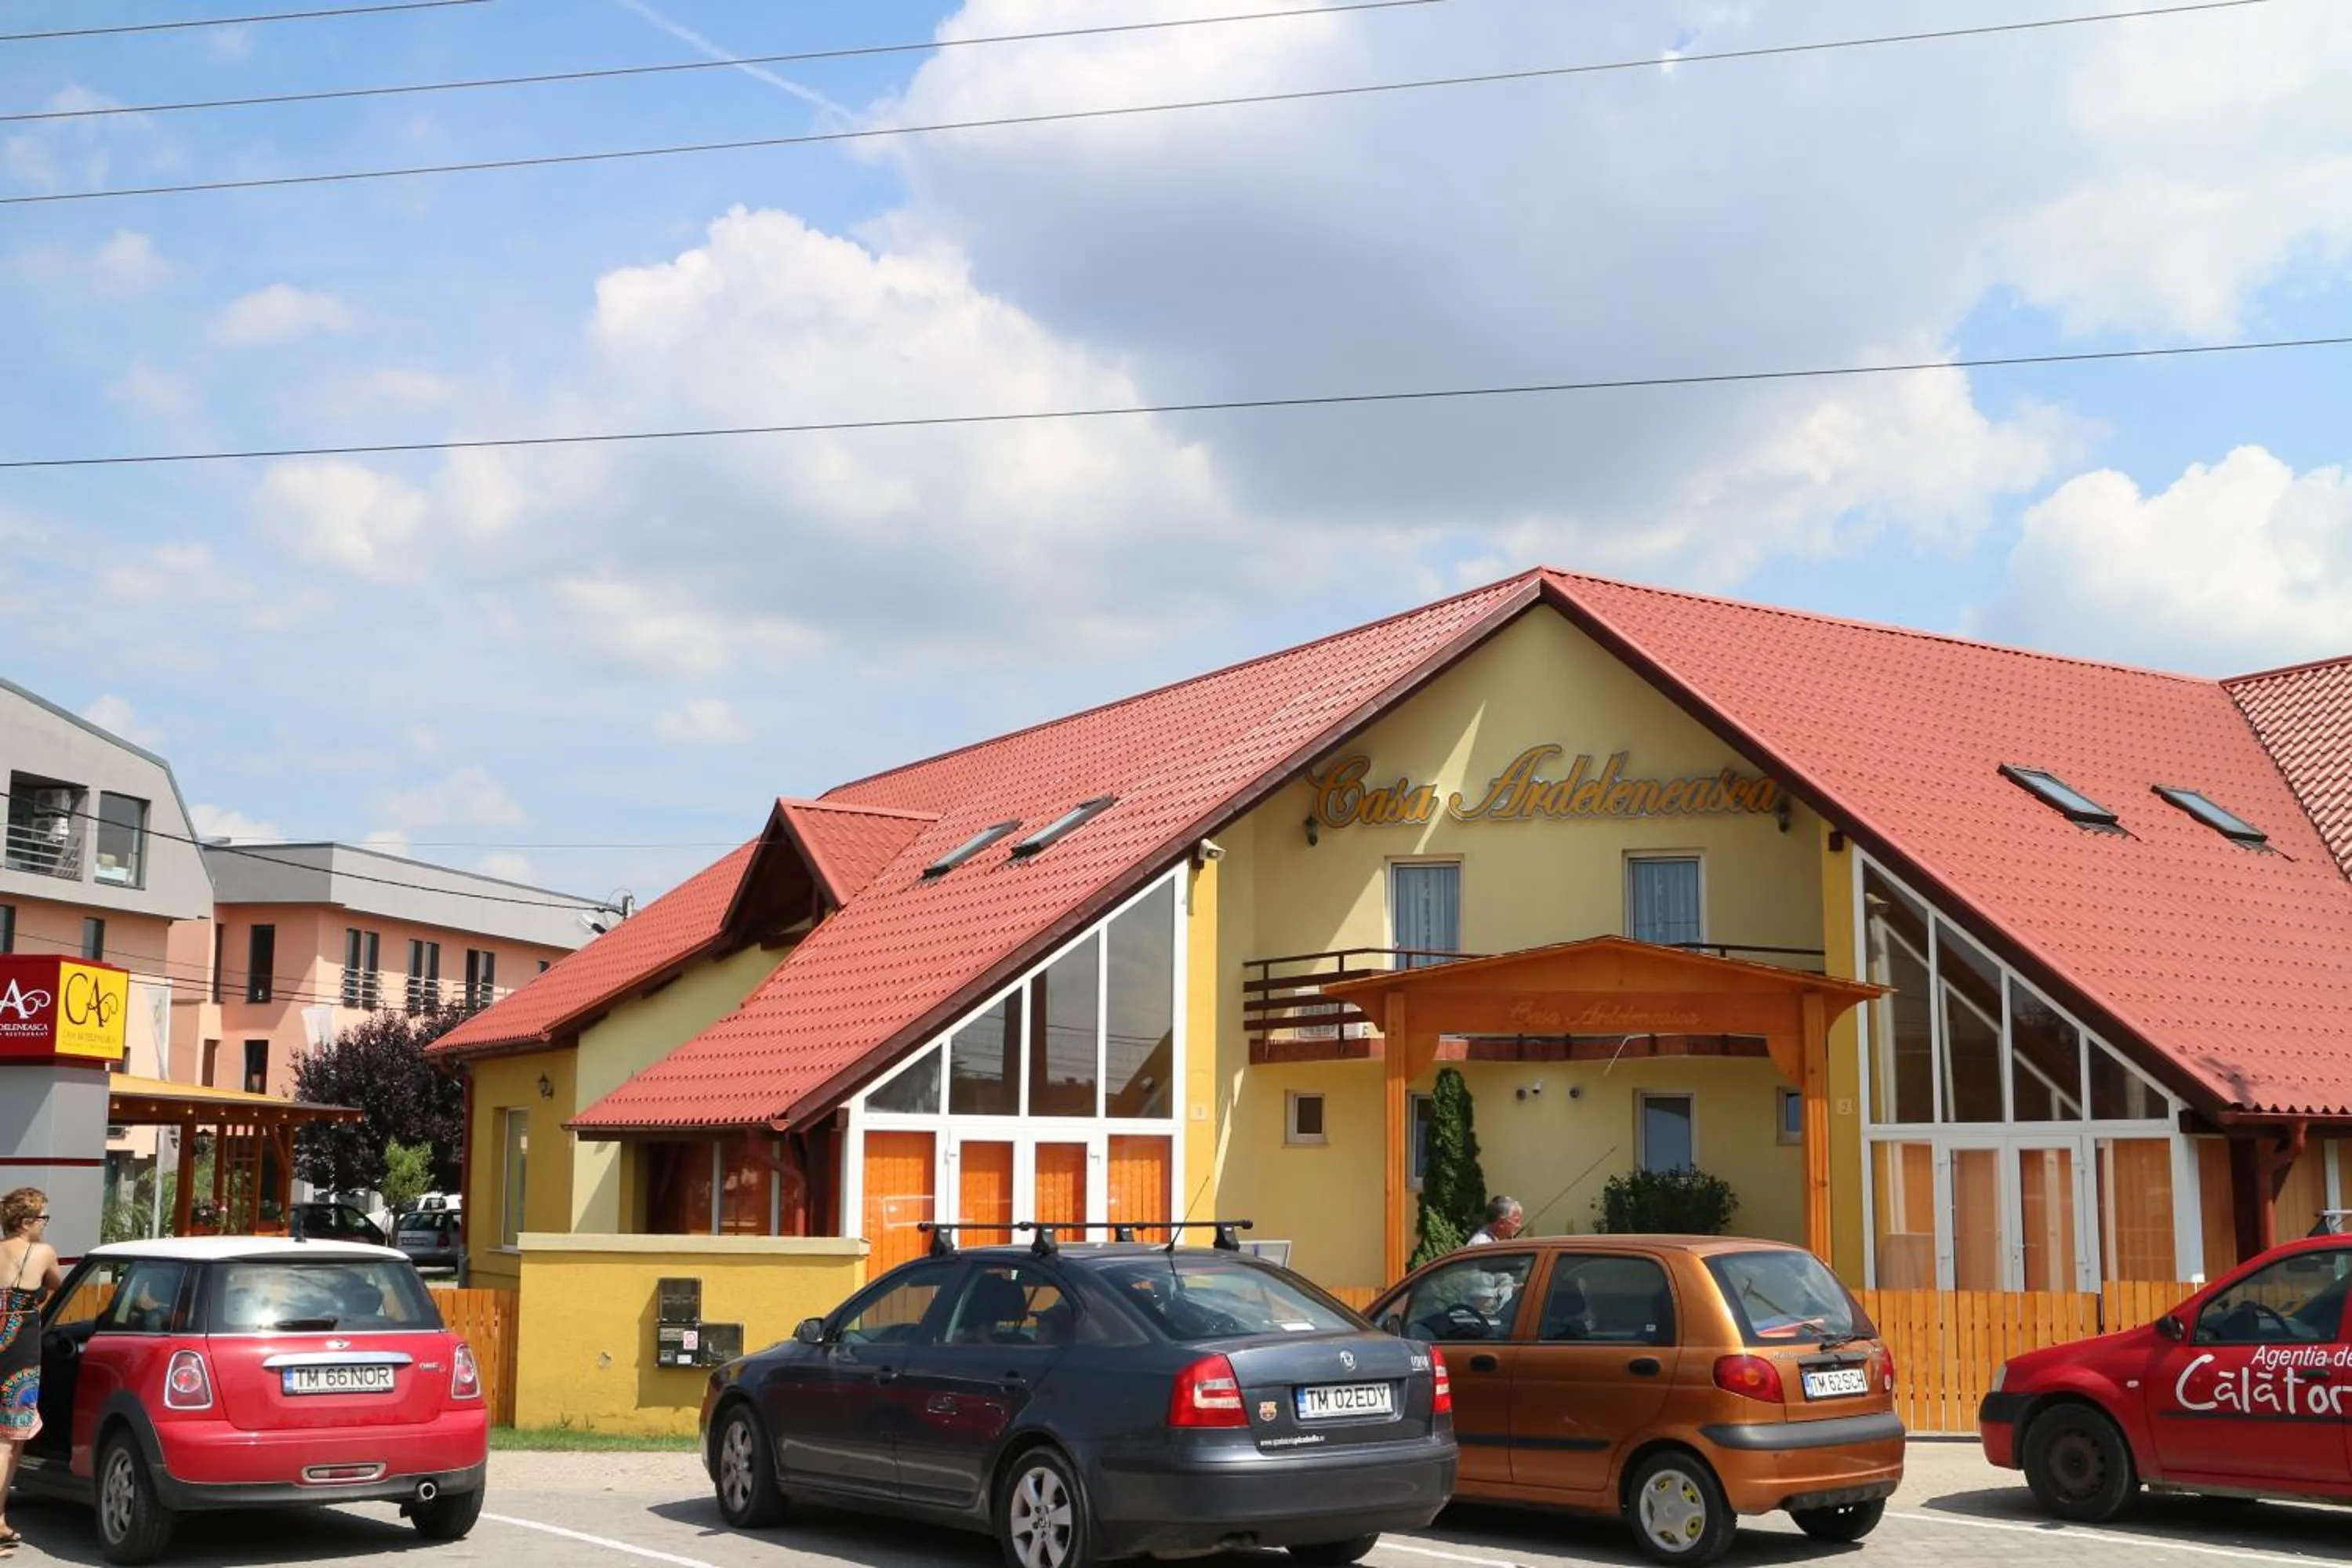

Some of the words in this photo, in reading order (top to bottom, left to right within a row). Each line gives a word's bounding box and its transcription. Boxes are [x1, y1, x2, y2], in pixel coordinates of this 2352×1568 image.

[1306, 754, 1441, 829] Casa
[1448, 744, 1777, 822] Ardeleneasca
[2252, 1345, 2327, 1370] Agentia
[296, 1369, 319, 1387] TM
[1307, 1389, 1329, 1410] TM
